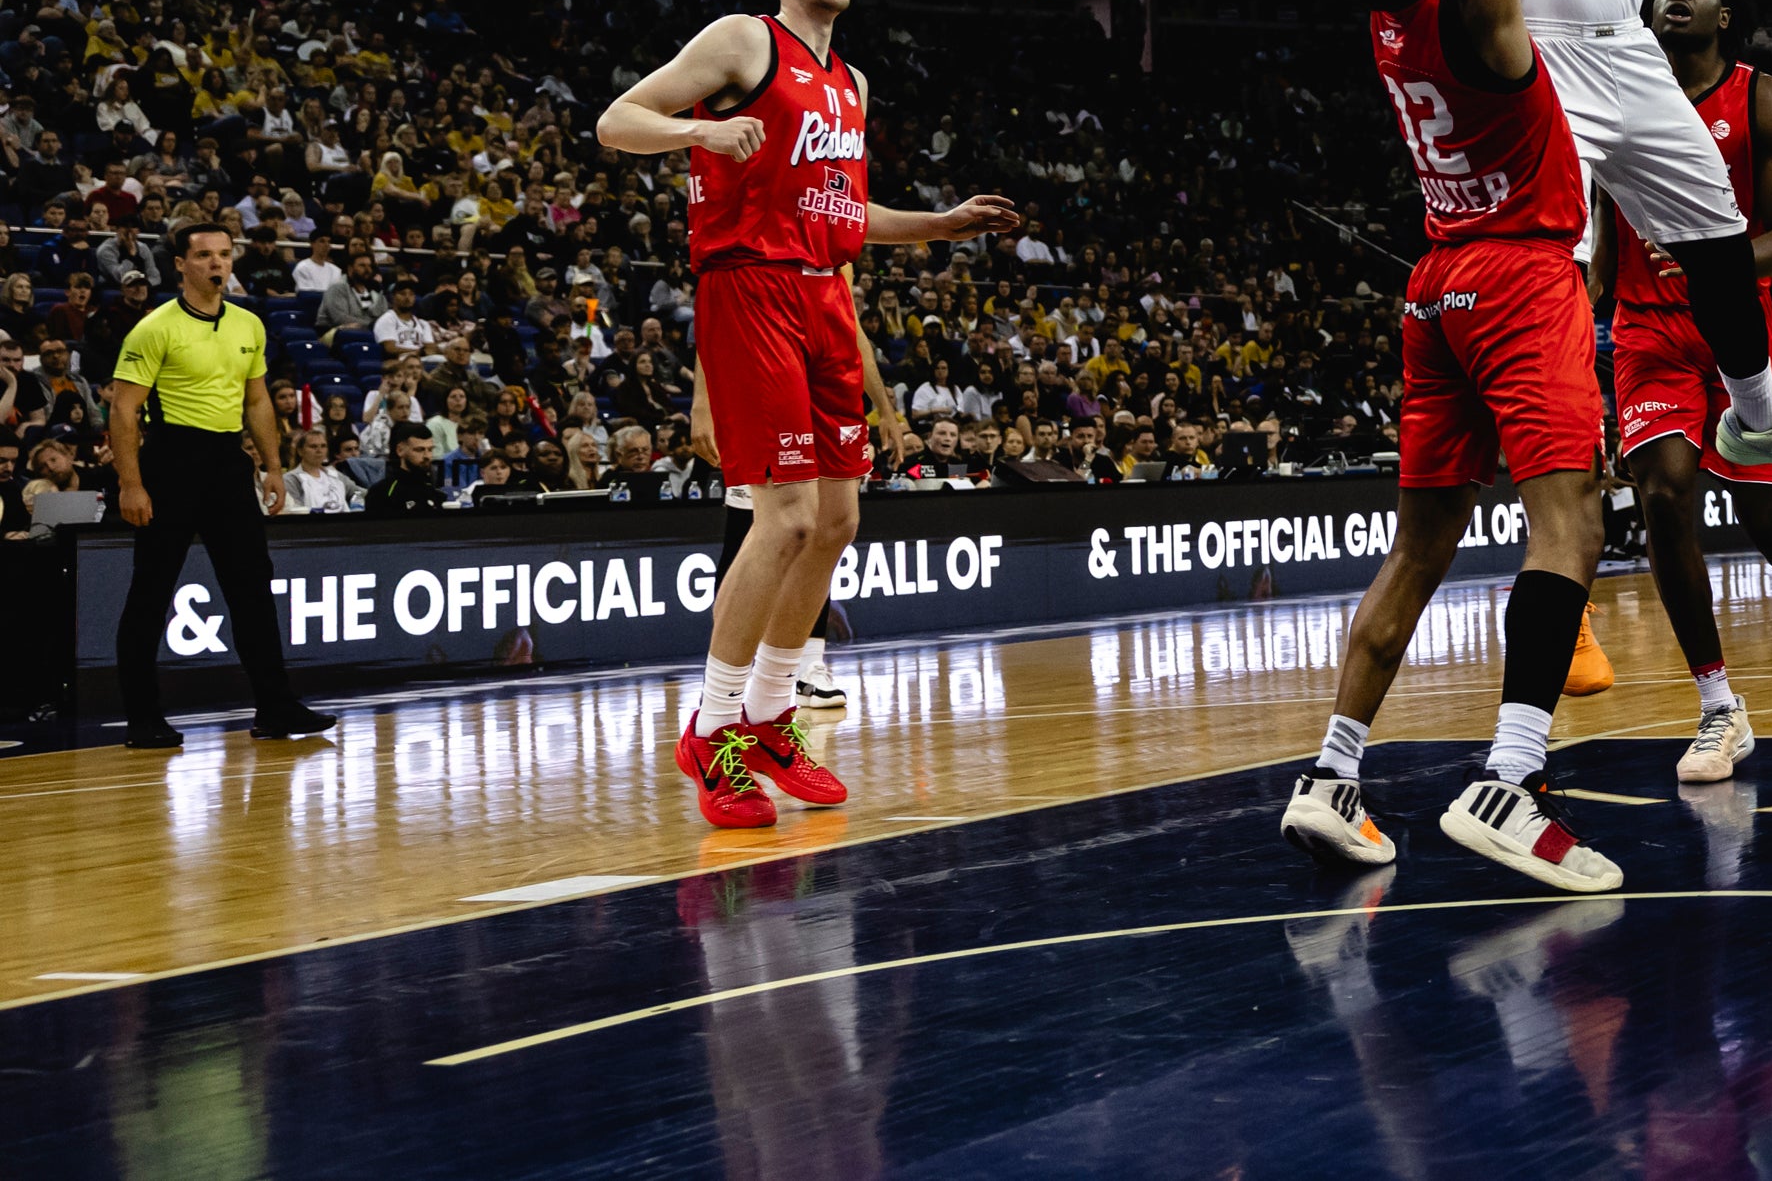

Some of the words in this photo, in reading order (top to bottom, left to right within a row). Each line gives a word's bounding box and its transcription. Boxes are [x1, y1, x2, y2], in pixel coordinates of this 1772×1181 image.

[790, 110, 865, 166] Riders
[1384, 73, 1471, 174] 12
[796, 209, 864, 232] HOMES
[799, 187, 864, 223] Jelson
[1443, 291, 1477, 310] Play
[1704, 490, 1722, 527] &
[1088, 528, 1119, 578] &
[1124, 524, 1192, 575] THE
[1198, 515, 1341, 569] OFFICIAL
[1491, 503, 1523, 545] OF
[167, 583, 228, 656] &
[393, 556, 665, 636] OFFICIAL
[676, 539, 938, 613] GBALL
[946, 535, 1002, 590] OF
